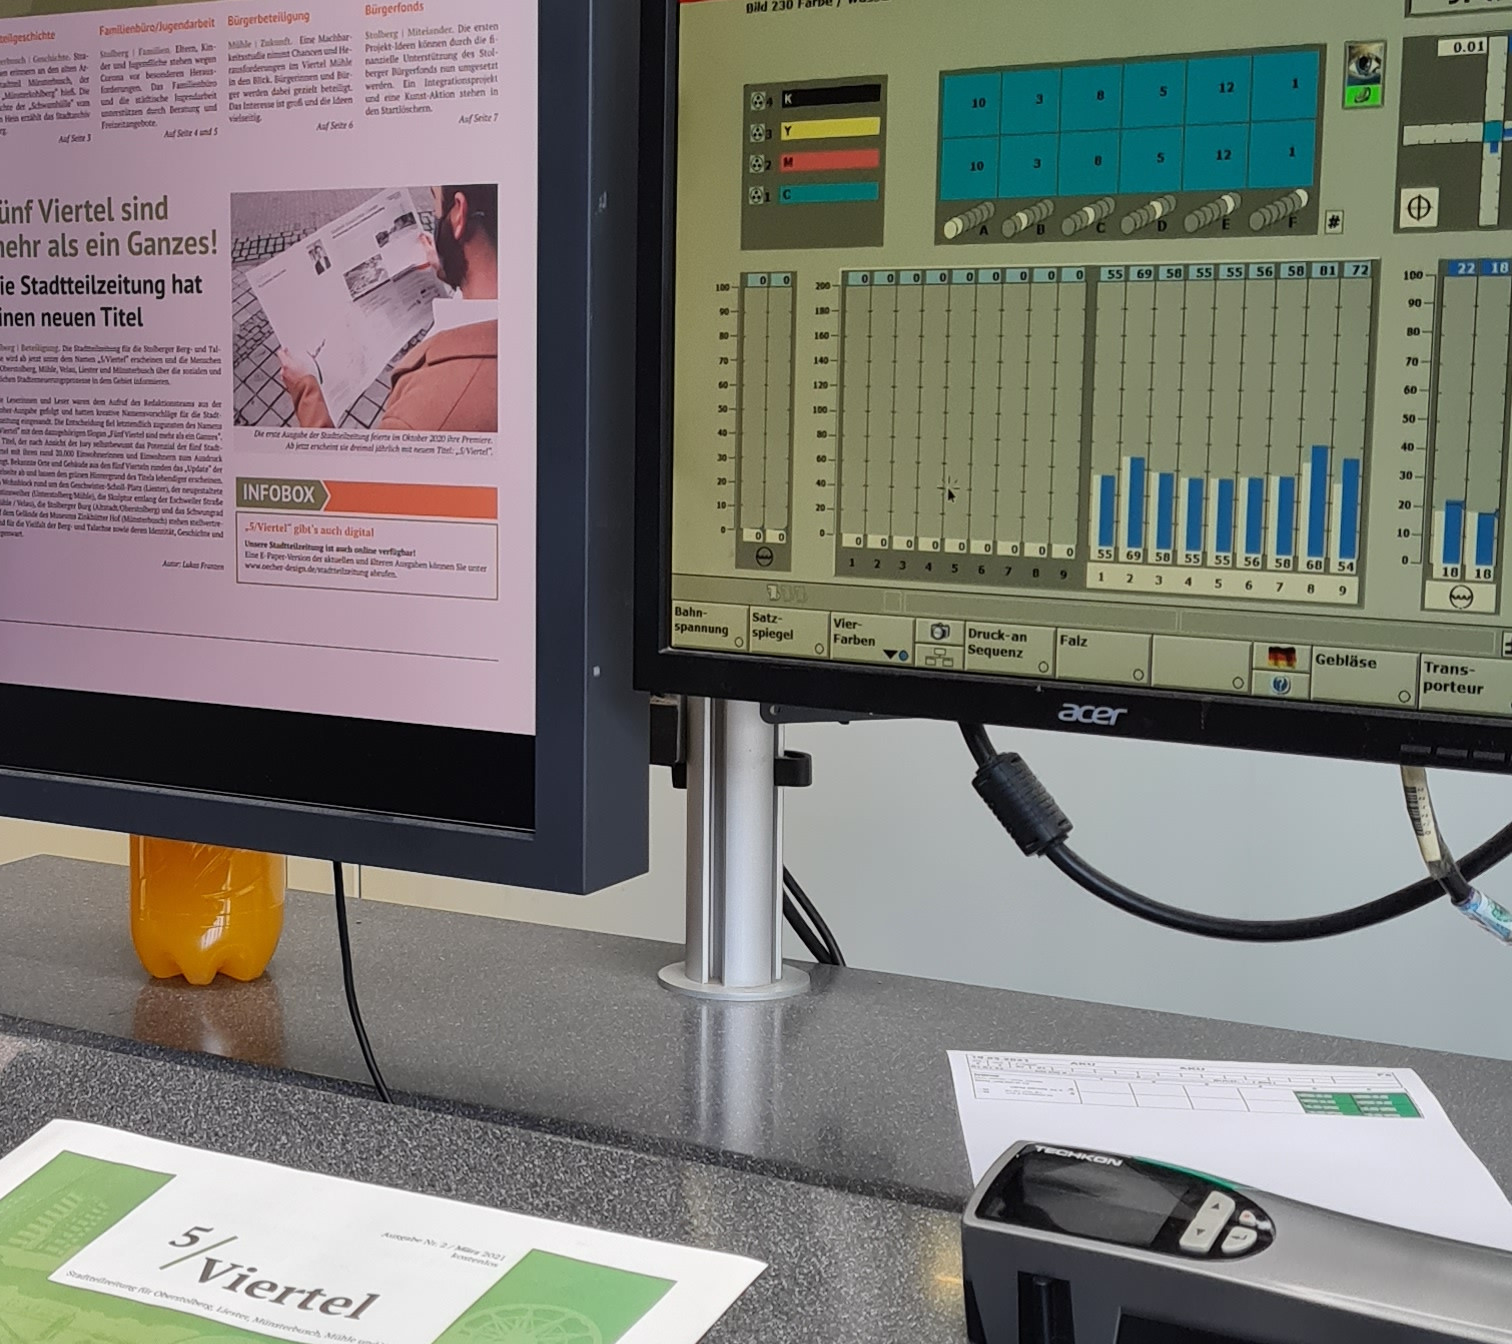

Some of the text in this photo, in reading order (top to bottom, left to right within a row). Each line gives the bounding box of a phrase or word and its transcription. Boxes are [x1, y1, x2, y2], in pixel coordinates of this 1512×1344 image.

[364, 2, 424, 16] Bürgerfonds
[746, 2, 768, 14] Bild
[772, 0, 794, 11] 230
[99, 18, 216, 36] Familienbüro/Jugendarbeit
[227, 11, 310, 28] Bürgerbeteiligung
[785, 93, 792, 104] K
[971, 97, 986, 109] 10
[1035, 94, 1044, 104] 3
[1159, 87, 1167, 97] 5
[1218, 82, 1235, 93] 12
[1292, 78, 1299, 89] 1
[784, 126, 792, 136] Y
[783, 157, 793, 167] M
[969, 161, 984, 172] 10
[1033, 159, 1041, 168] 3
[1156, 153, 1165, 164] 5
[1215, 149, 1232, 161] 12
[1288, 146, 1296, 157] 1
[783, 189, 791, 200] C
[38, 197, 114, 223] Viertel
[122, 195, 168, 220] sind
[979, 226, 989, 236] A
[1096, 222, 1106, 233] C
[1158, 221, 1167, 232] D
[1222, 219, 1231, 230] E
[1288, 217, 1297, 228] F
[48, 232, 78, 257] als
[86, 232, 120, 256] ein
[127, 229, 217, 256] Ganzes!
[20, 274, 165, 299] Stadtteilzeitung
[172, 274, 202, 294] hat
[42, 306, 96, 327] neuen
[100, 306, 143, 327] Titel
[243, 482, 315, 503] INFOBOX
[320, 526, 342, 536] auch
[344, 526, 374, 538] digital
[675, 606, 708, 619] Bahn-
[752, 611, 783, 625] Satz-
[675, 623, 728, 638] spannung
[833, 618, 862, 631] Vier-
[752, 627, 794, 642] spiegel
[833, 633, 876, 647] Farben
[968, 628, 1027, 643] Druck-an
[1060, 634, 1087, 647] Falz
[967, 643, 1024, 659] Sequenz
[1315, 654, 1377, 670] Gebläse
[1423, 660, 1476, 677] Trans-
[1423, 680, 1484, 697] porteur
[1057, 702, 1128, 726] acer
[1033, 1143, 1124, 1167] TECHKON
